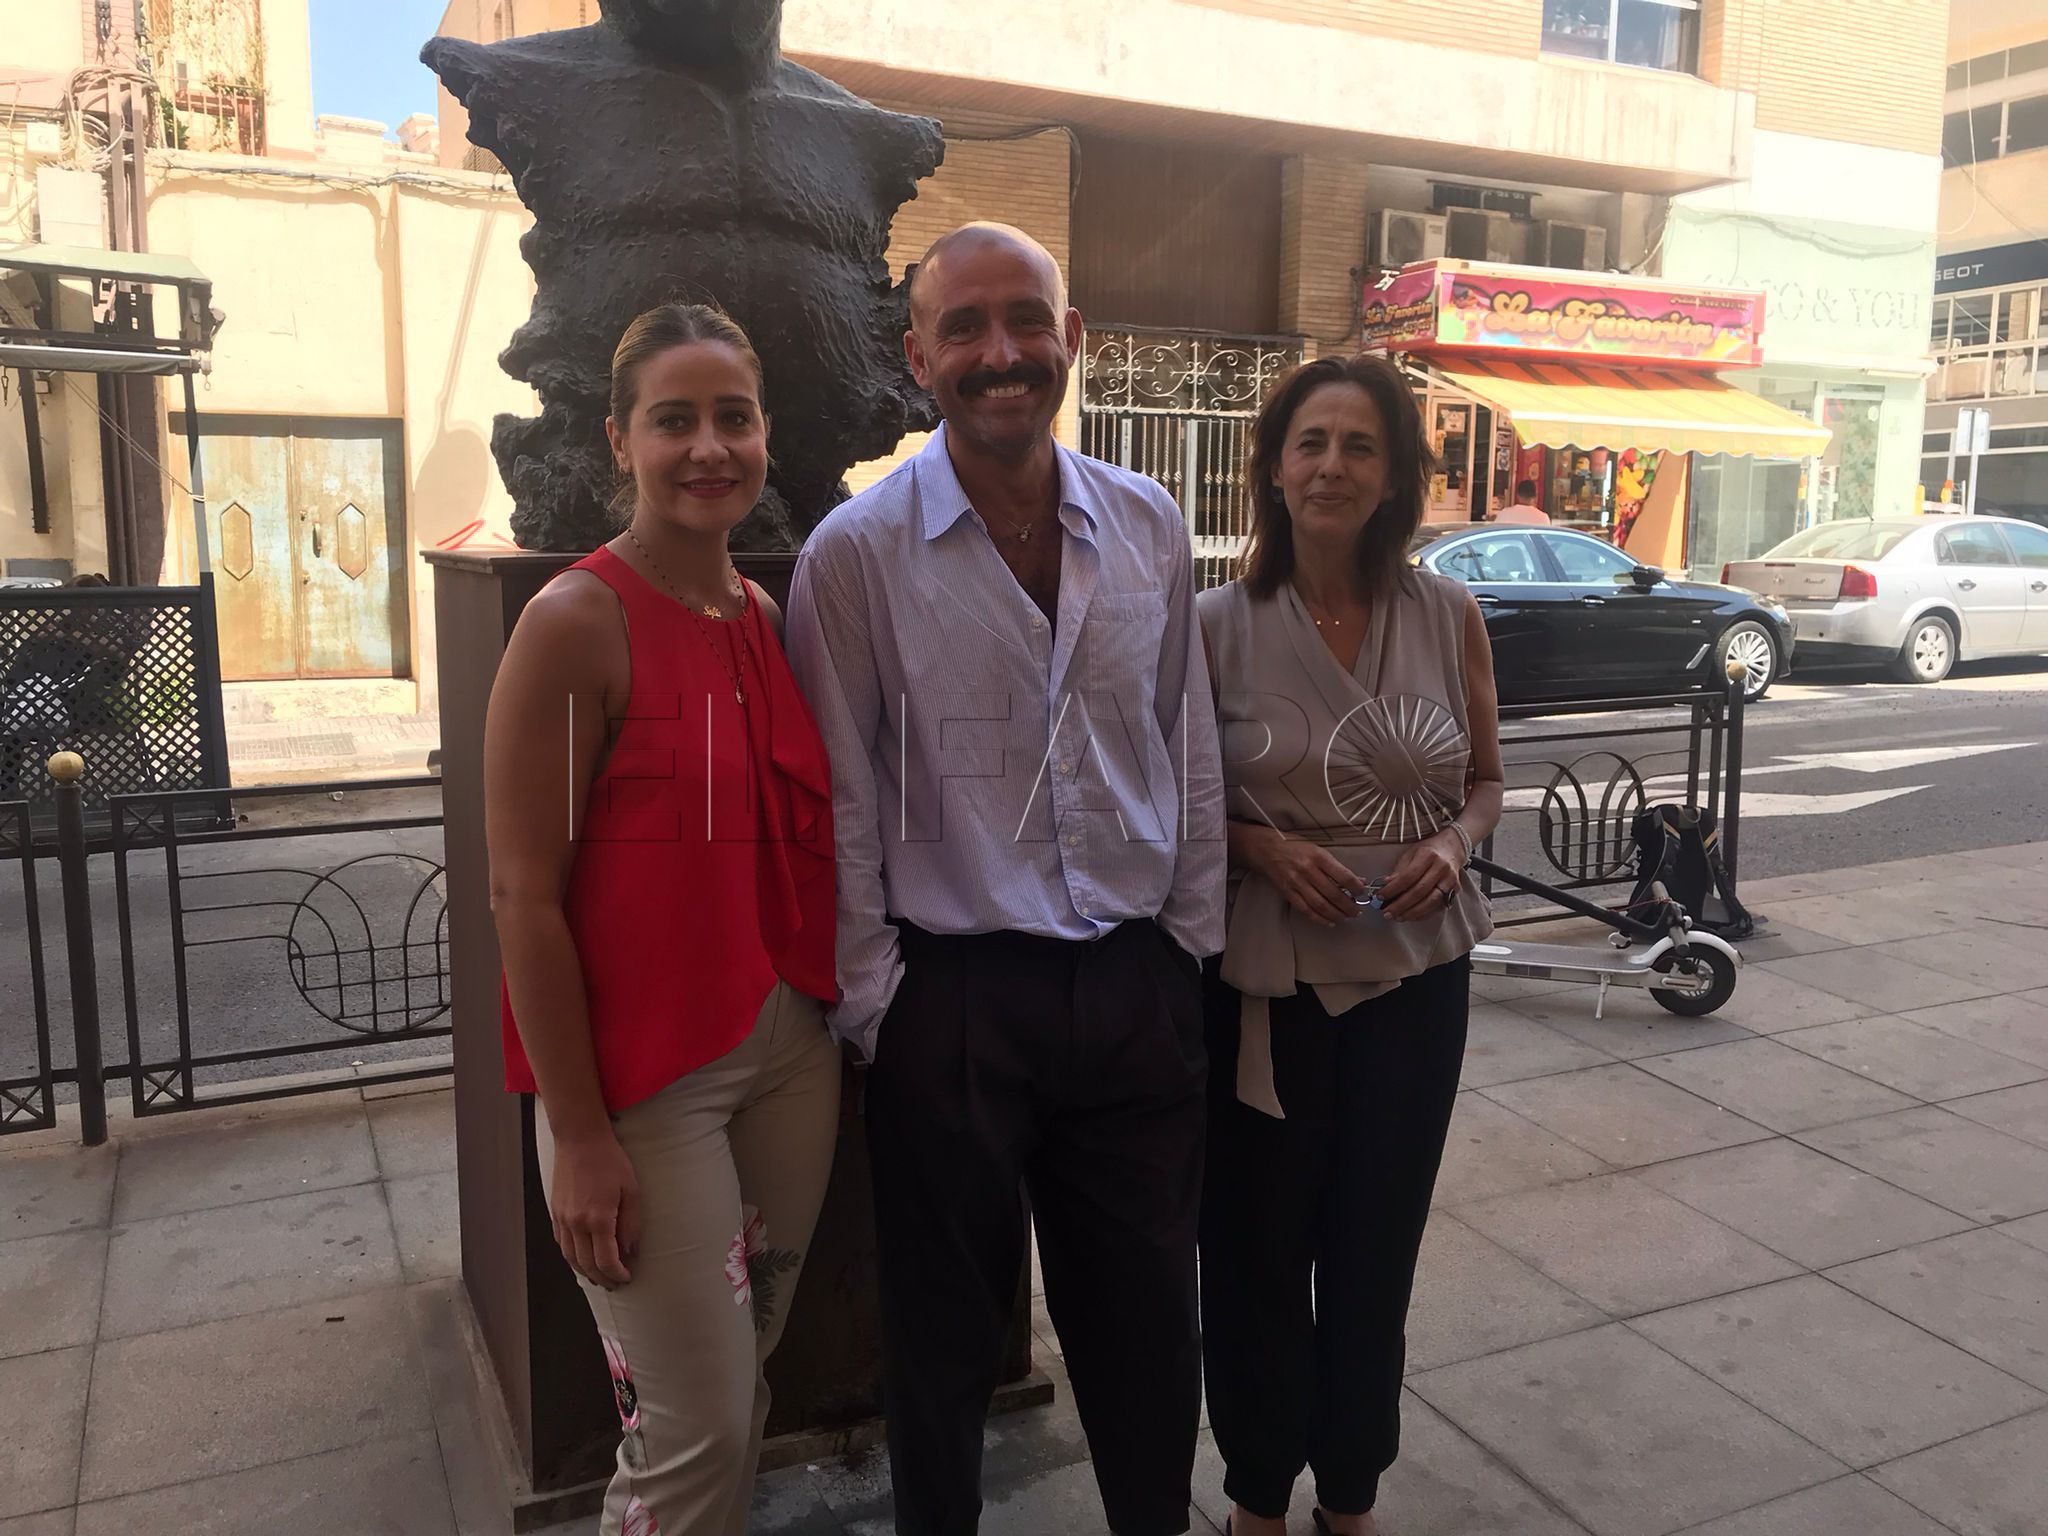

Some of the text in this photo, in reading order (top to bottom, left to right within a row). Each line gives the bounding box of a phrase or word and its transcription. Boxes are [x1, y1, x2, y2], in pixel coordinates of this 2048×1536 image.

[1935, 263, 1985, 282] GEOT
[1485, 291, 1552, 333] La
[1555, 299, 1715, 346] Favorita
[1848, 287, 1920, 330] YOU
